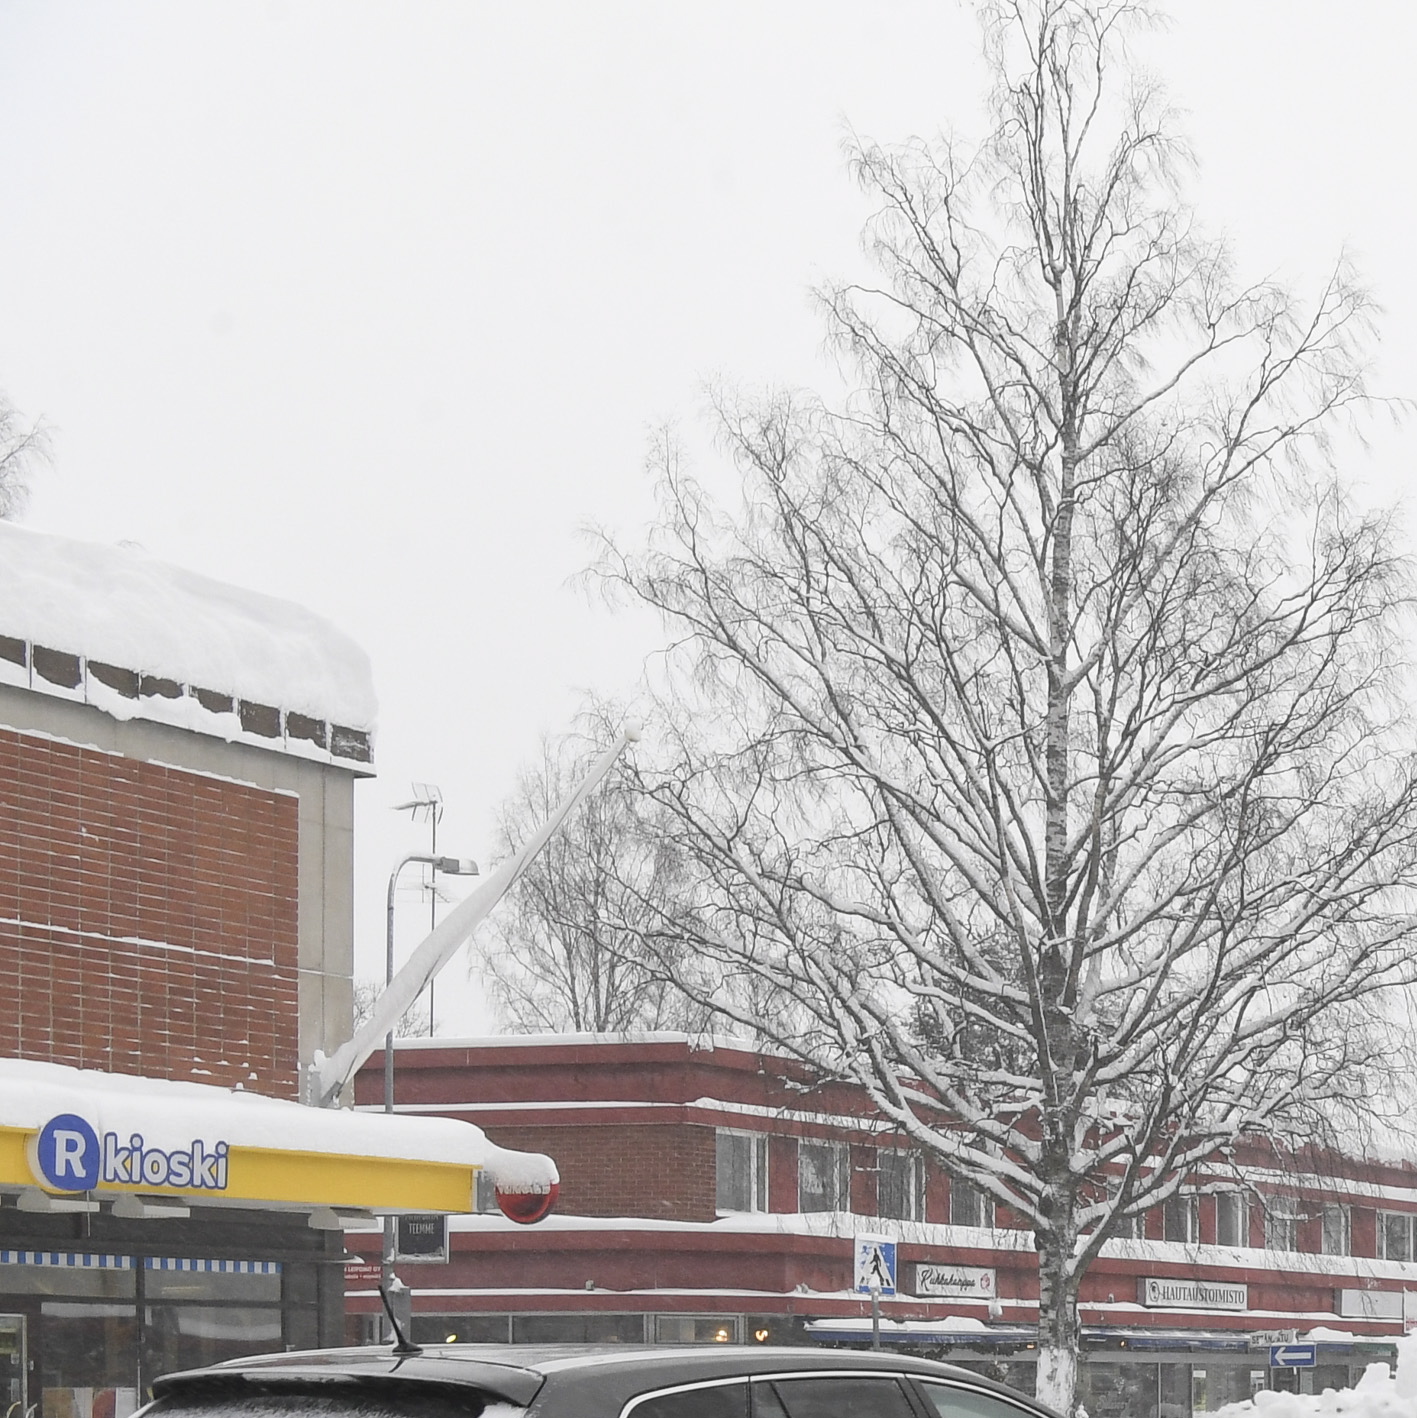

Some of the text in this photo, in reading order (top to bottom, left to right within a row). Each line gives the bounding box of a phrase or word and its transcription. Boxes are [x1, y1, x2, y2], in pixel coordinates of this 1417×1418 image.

[53, 1129, 229, 1190] R kioski
[1162, 1285, 1246, 1305] HAUTAUSTOIMISTO
